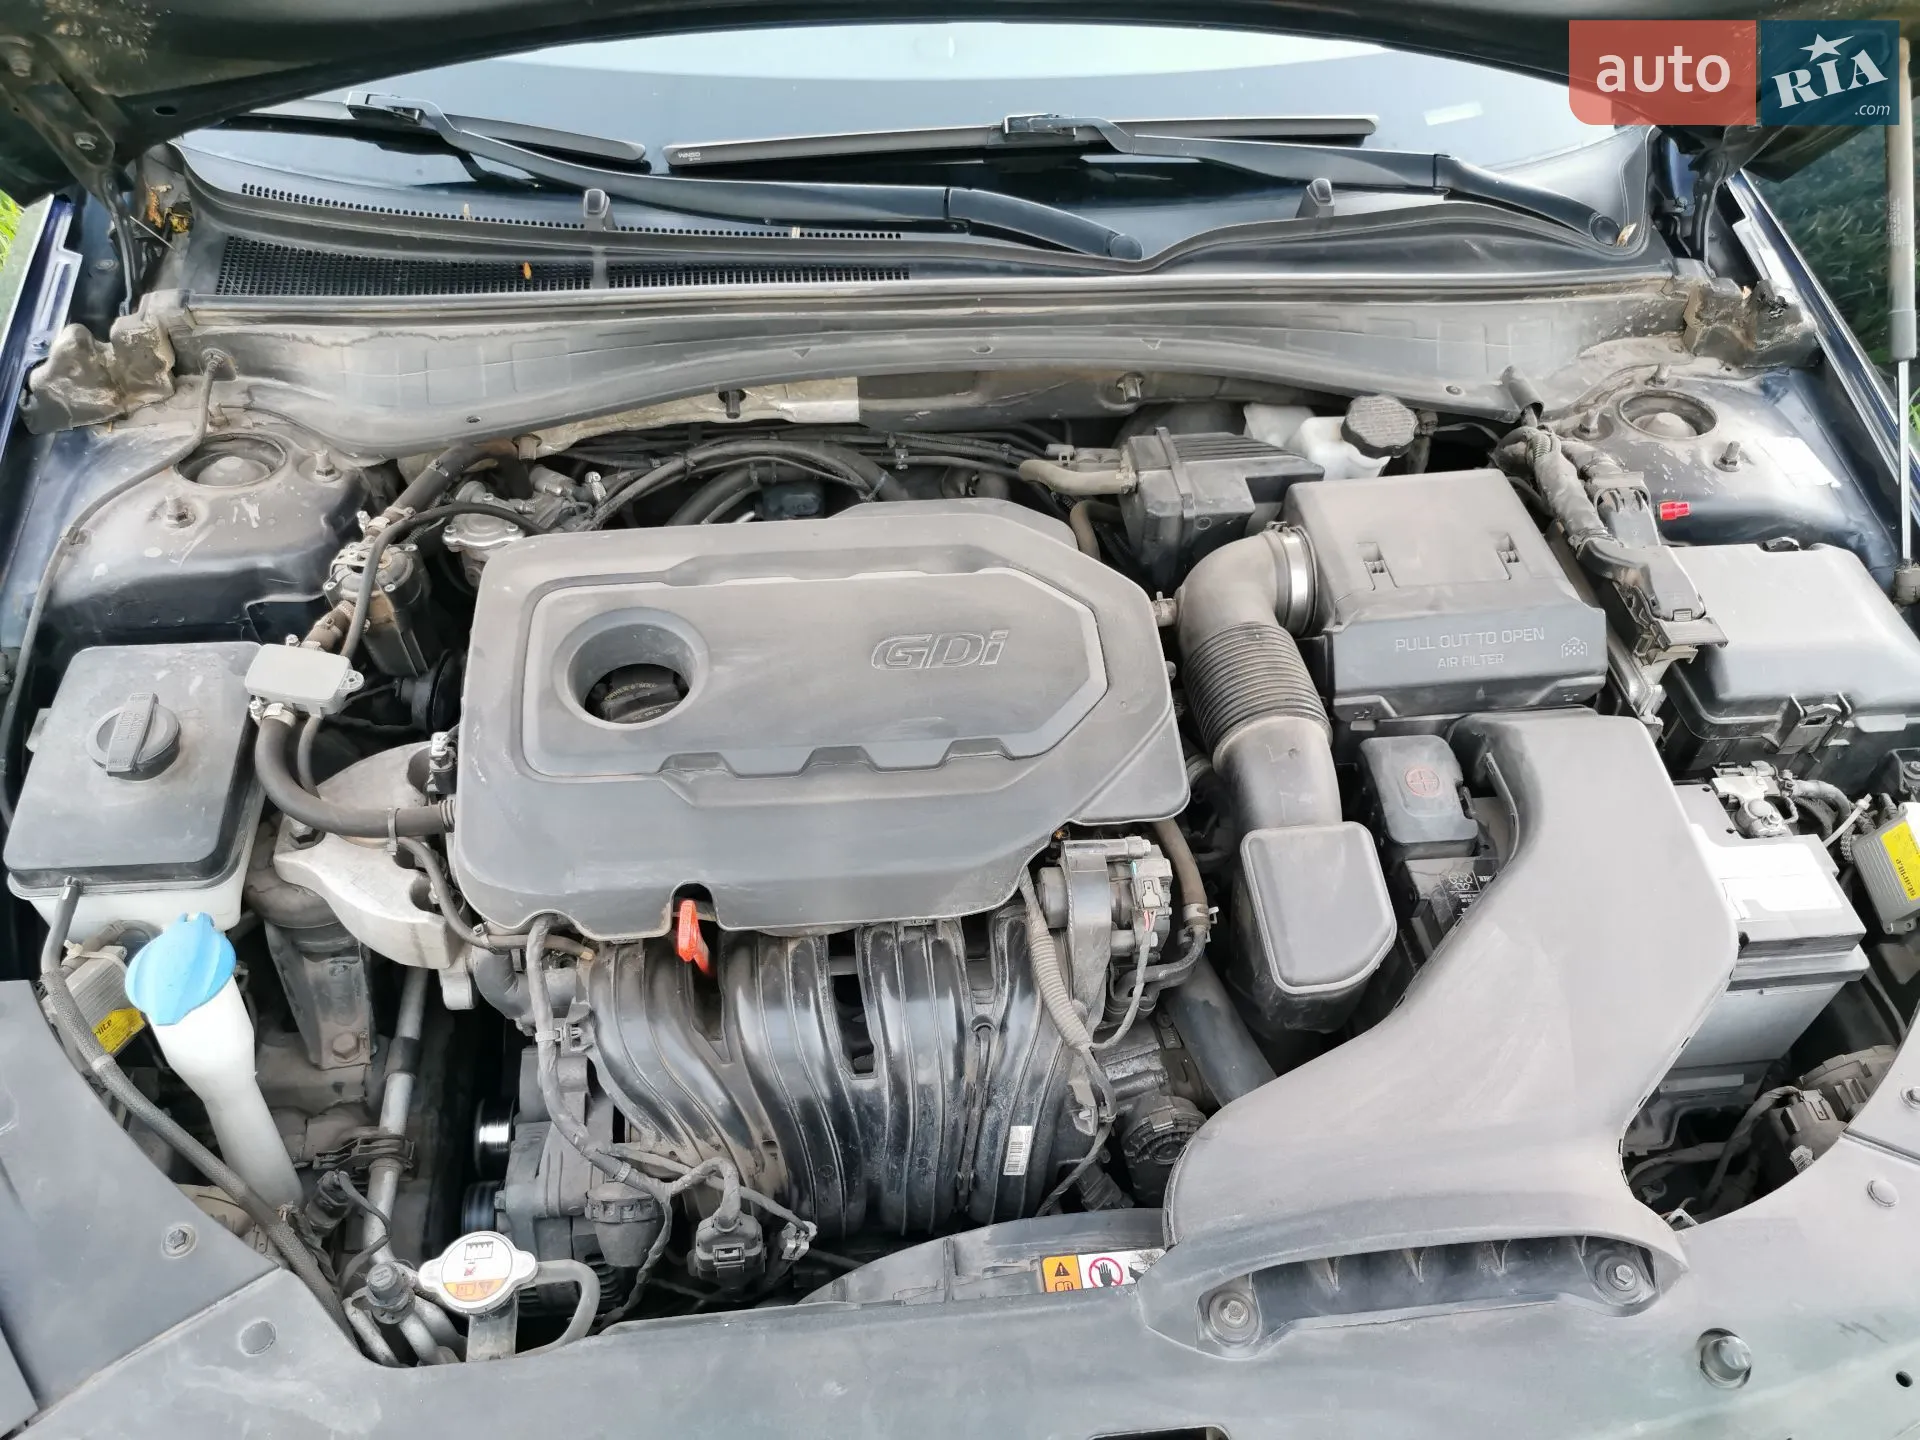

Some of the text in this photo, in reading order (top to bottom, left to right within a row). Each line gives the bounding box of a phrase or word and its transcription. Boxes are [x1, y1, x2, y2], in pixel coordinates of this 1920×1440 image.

[871, 630, 1009, 670] GDi
[1395, 626, 1545, 652] PULL OUT TO OPEN
[1437, 653, 1505, 669] AIR FILTER
